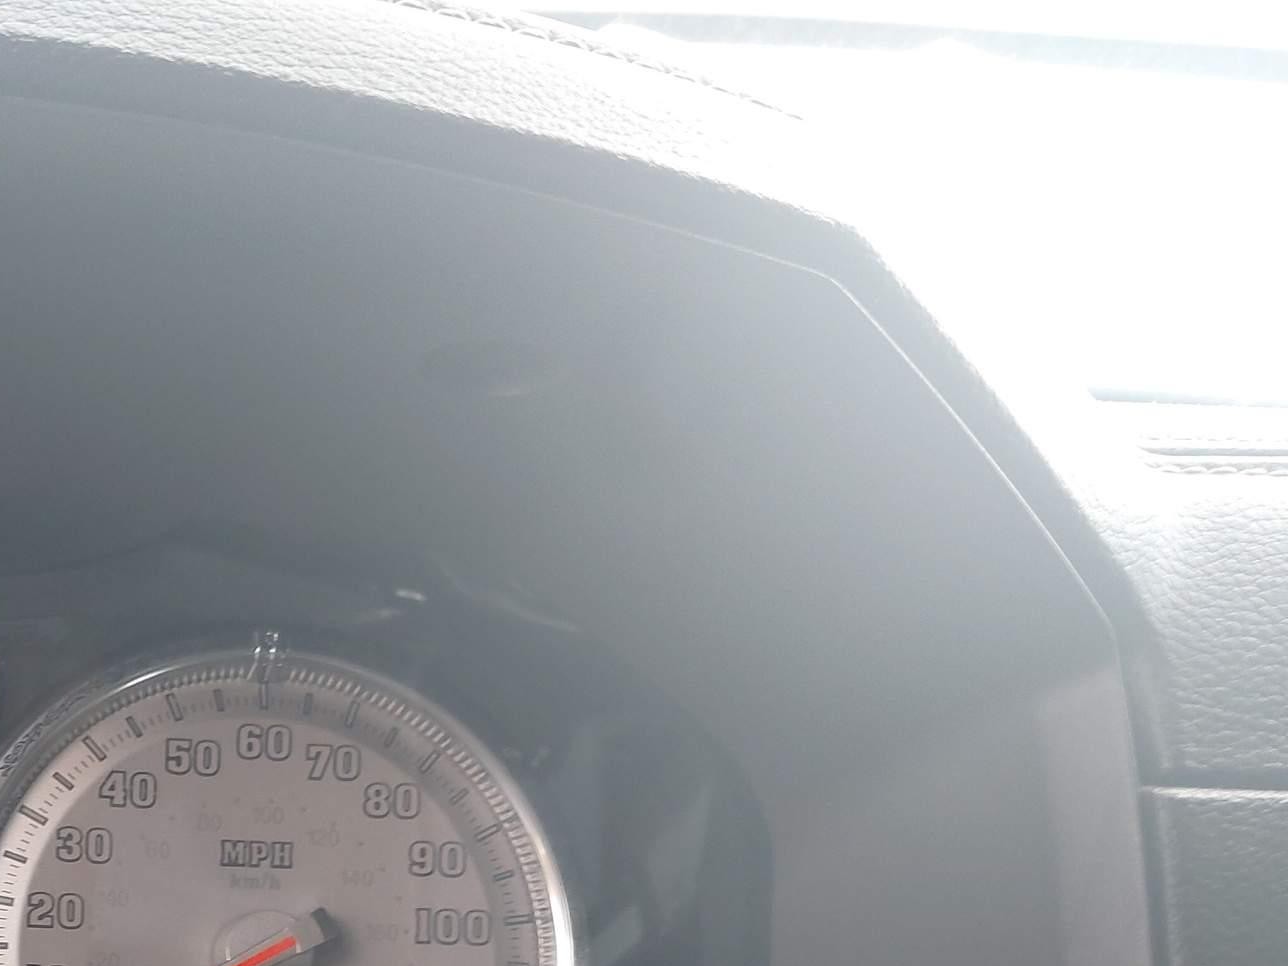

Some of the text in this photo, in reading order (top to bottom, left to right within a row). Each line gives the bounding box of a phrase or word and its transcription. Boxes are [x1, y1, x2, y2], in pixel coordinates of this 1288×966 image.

[164, 737, 221, 776] 50
[235, 723, 292, 762] 60
[305, 743, 362, 782] 70
[98, 770, 157, 808] 40
[363, 782, 421, 820] 80
[55, 826, 113, 865] 30
[220, 839, 294, 869] MPH
[407, 840, 467, 879] 90
[26, 891, 84, 929] 20
[415, 908, 491, 947] 100
